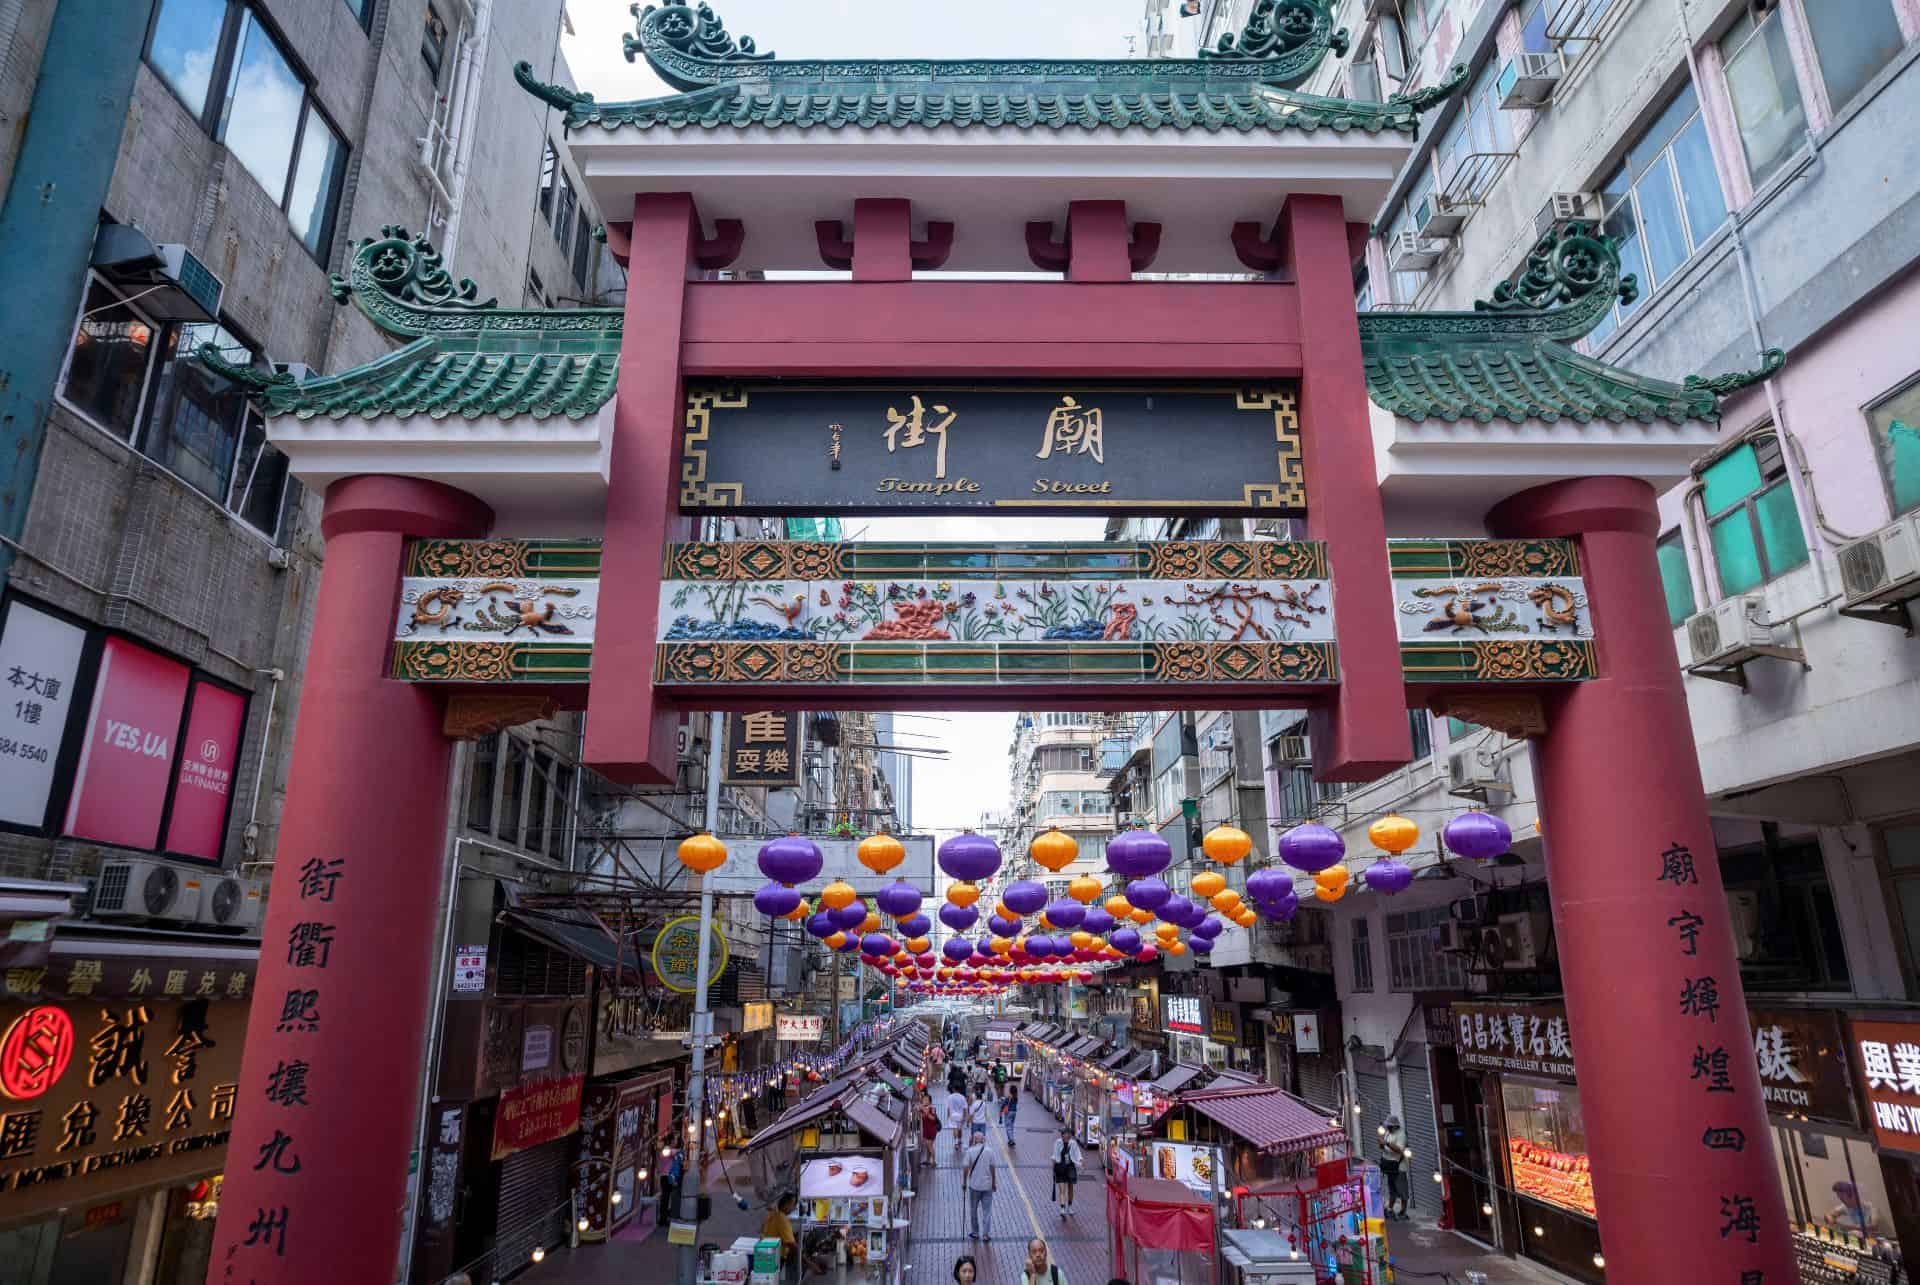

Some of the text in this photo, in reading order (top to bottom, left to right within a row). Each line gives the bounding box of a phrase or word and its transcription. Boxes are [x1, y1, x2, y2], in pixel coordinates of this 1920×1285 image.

[876, 478, 1112, 496] Temple Street
[8, 666, 62, 700] 本大廈
[15, 701, 43, 726] 1樓
[20, 744, 48, 763] 5540
[736, 749, 789, 773] 耍樂
[1550, 1063, 1576, 1076] WATCH
[1873, 1101, 1909, 1133] HING
